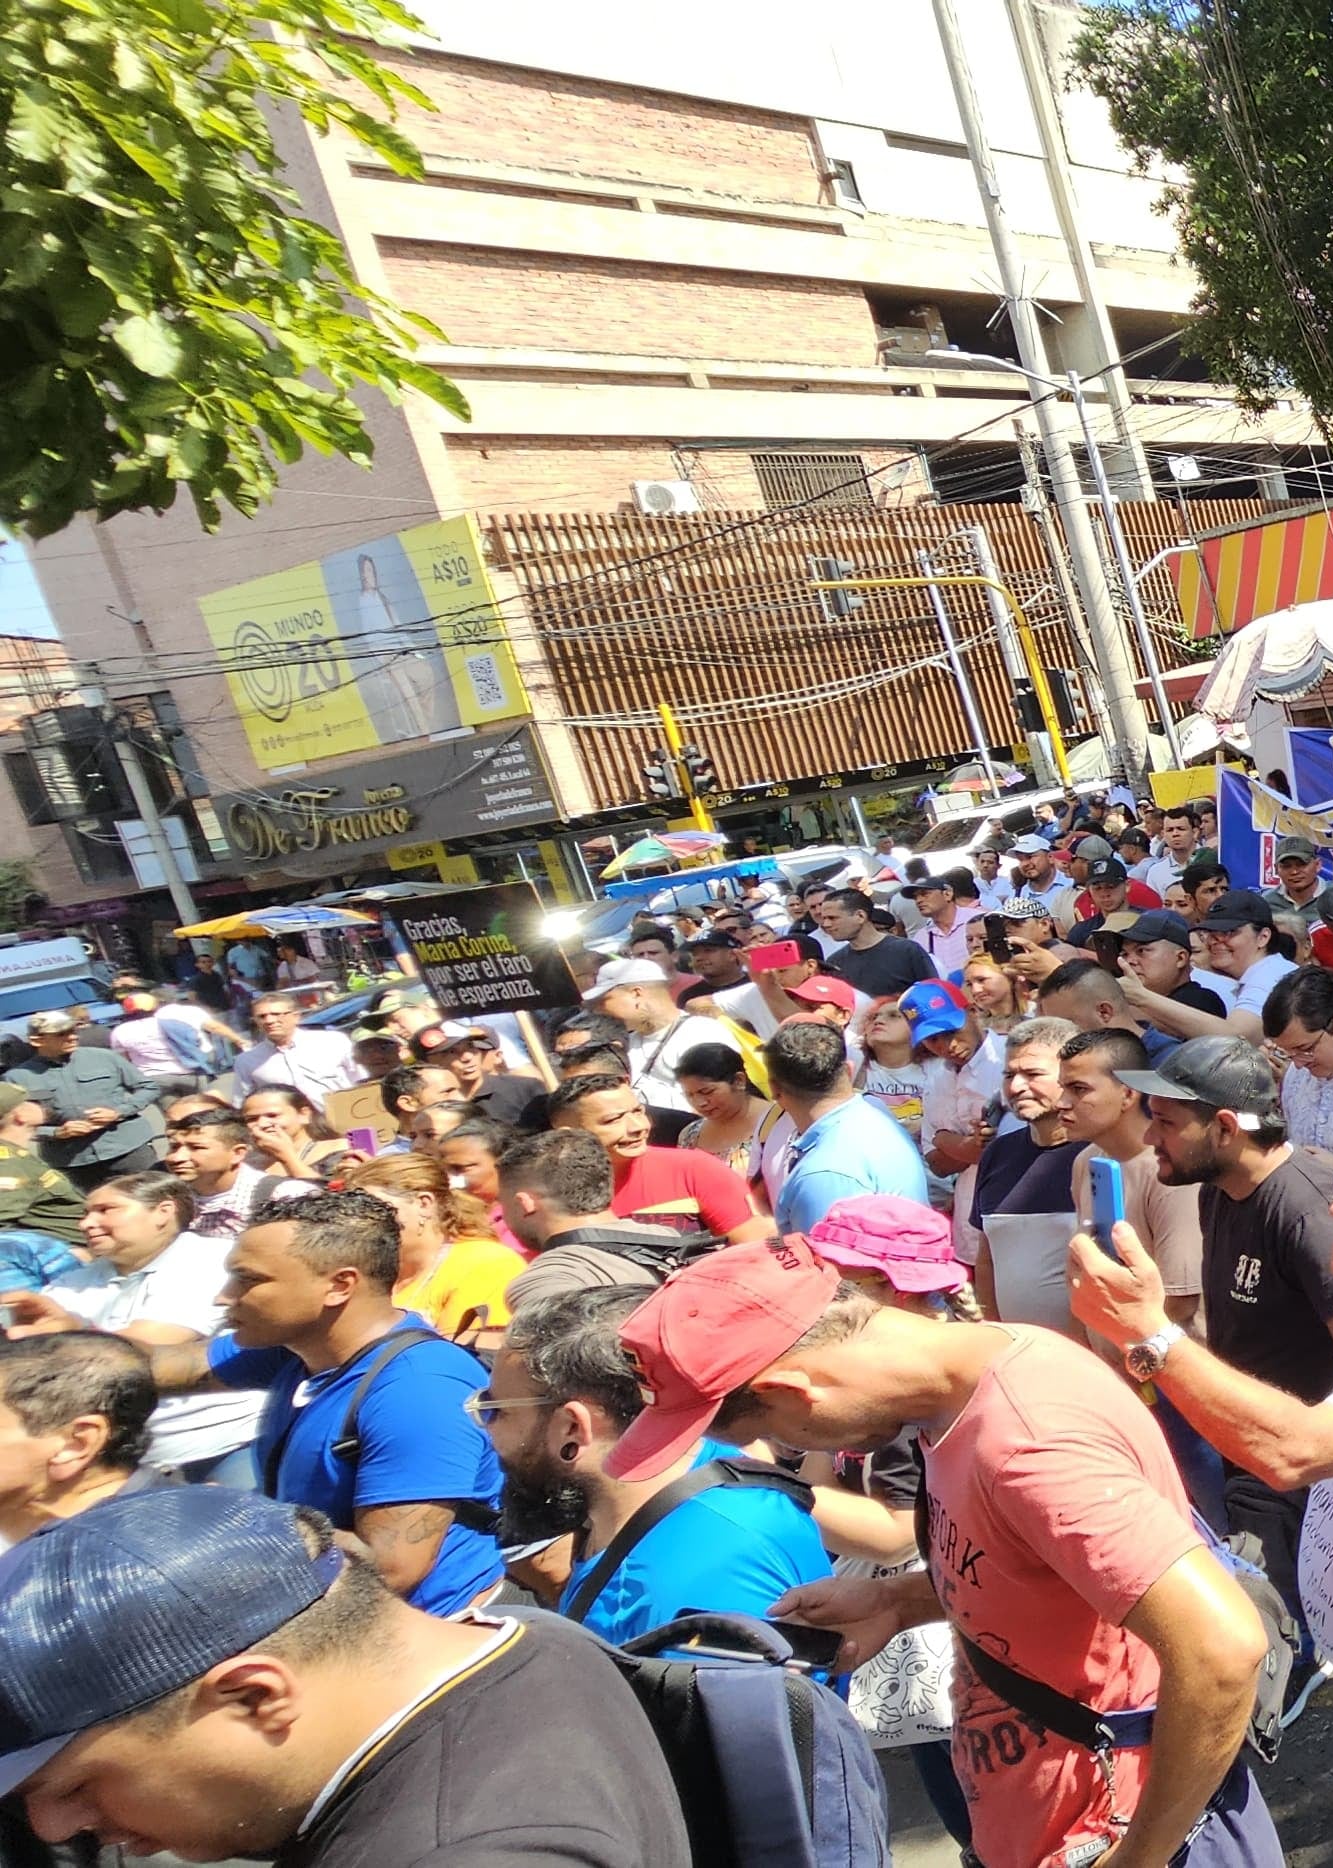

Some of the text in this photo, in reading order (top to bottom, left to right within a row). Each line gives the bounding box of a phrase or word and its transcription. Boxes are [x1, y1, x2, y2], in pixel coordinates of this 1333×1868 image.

[274, 608, 324, 639] MUNDO
[884, 767, 897, 778] 20
[717, 793, 733, 806] 20
[402, 913, 468, 941] Gracias,
[461, 930, 518, 958] Corina,
[425, 952, 534, 991] por ser el faro
[437, 978, 541, 1009] de esperanza.
